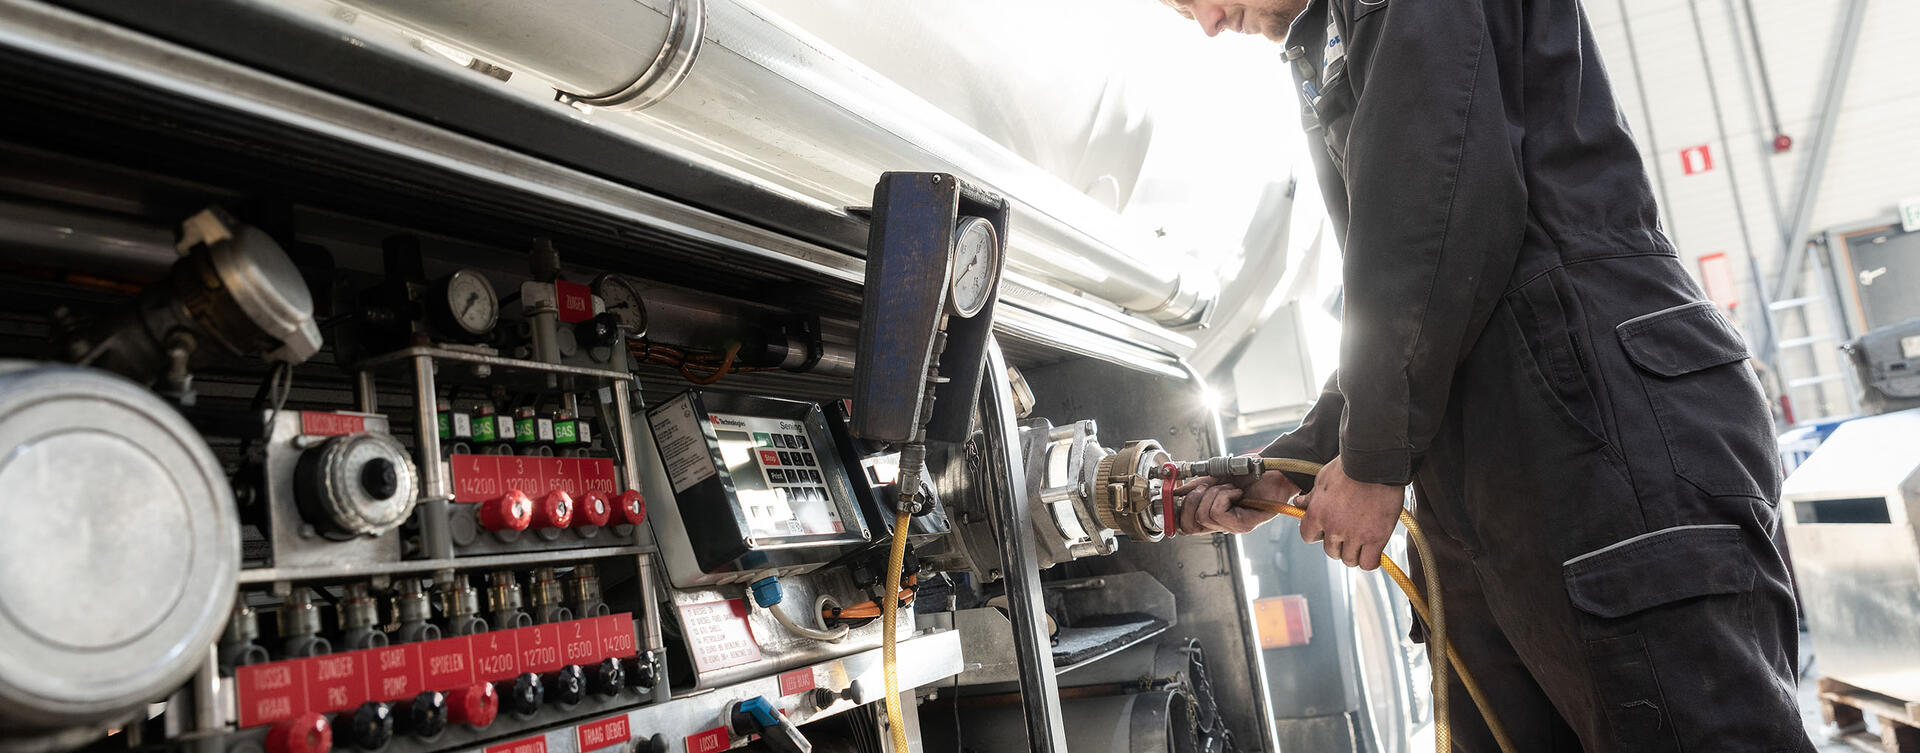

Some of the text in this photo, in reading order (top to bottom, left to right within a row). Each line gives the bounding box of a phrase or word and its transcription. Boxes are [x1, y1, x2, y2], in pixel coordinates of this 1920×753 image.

[555, 425, 575, 438] GAS.
[473, 459, 480, 473] 4
[517, 459, 524, 474] 3
[764, 454, 776, 463] Stop
[557, 460, 564, 475] 2
[595, 461, 600, 474] 1
[461, 478, 496, 495] 14200
[506, 478, 538, 494] 12700
[550, 478, 575, 494] 6500
[585, 478, 612, 493] 14200
[575, 623, 582, 638] 2
[613, 618, 618, 631] 1
[490, 636, 498, 650] 4
[535, 629, 542, 645] 3
[604, 635, 631, 652] 14200
[523, 647, 556, 667] 12700
[567, 641, 592, 660] 6500
[380, 648, 406, 670] START
[430, 653, 464, 676] SPOELEN
[479, 653, 513, 674] 14200
[317, 656, 353, 681] ZONDER
[570, 677, 579, 693] 3
[609, 669, 618, 685] 2
[383, 675, 407, 697] POMP
[525, 686, 534, 703] 4
[257, 697, 292, 720] KRAAN
[584, 721, 626, 746] TRAAG DEBIET
[699, 734, 718, 752] LOSSEN
